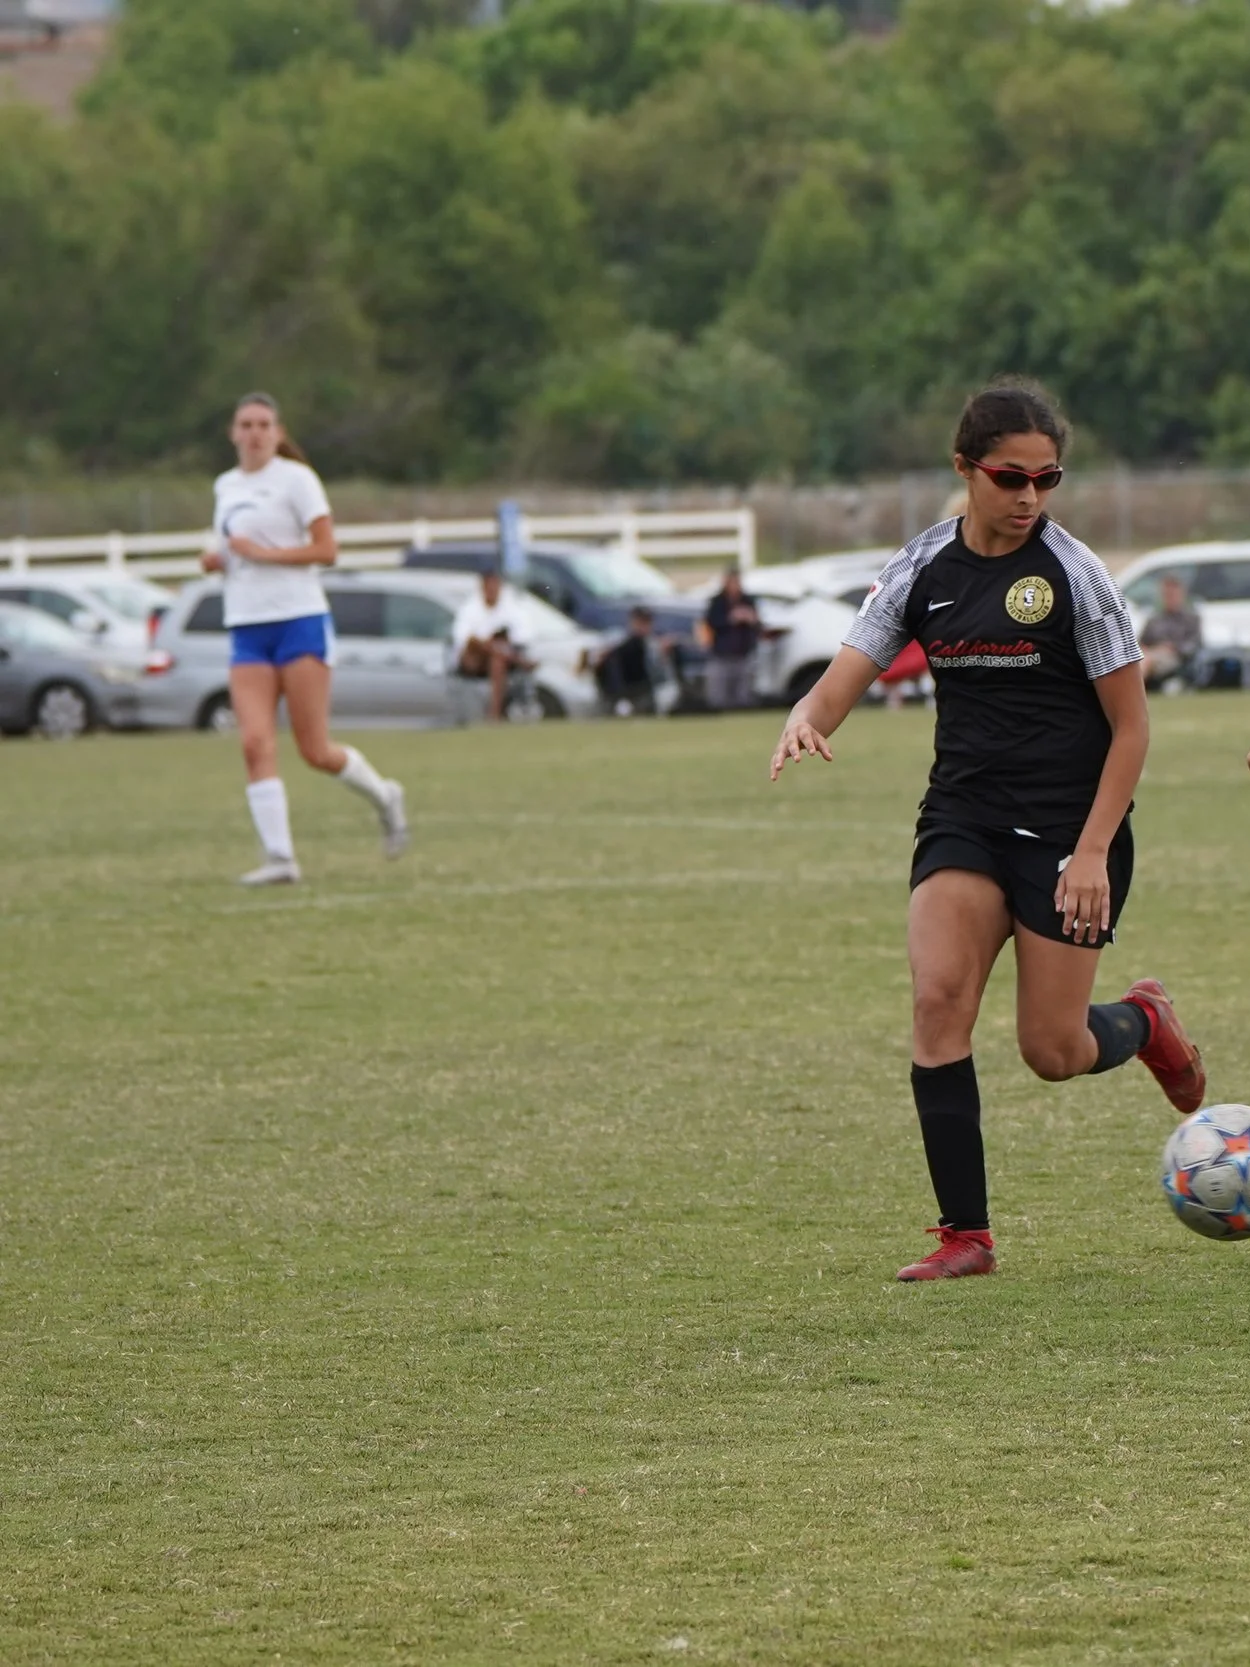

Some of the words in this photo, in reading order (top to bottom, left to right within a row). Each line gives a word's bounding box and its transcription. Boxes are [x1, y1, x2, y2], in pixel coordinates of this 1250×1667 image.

[1008, 602, 1034, 622] FOOTBALL
[1035, 605, 1050, 621] CLUB
[928, 639, 1034, 656] California
[928, 653, 1041, 668] TRANSMISSION
